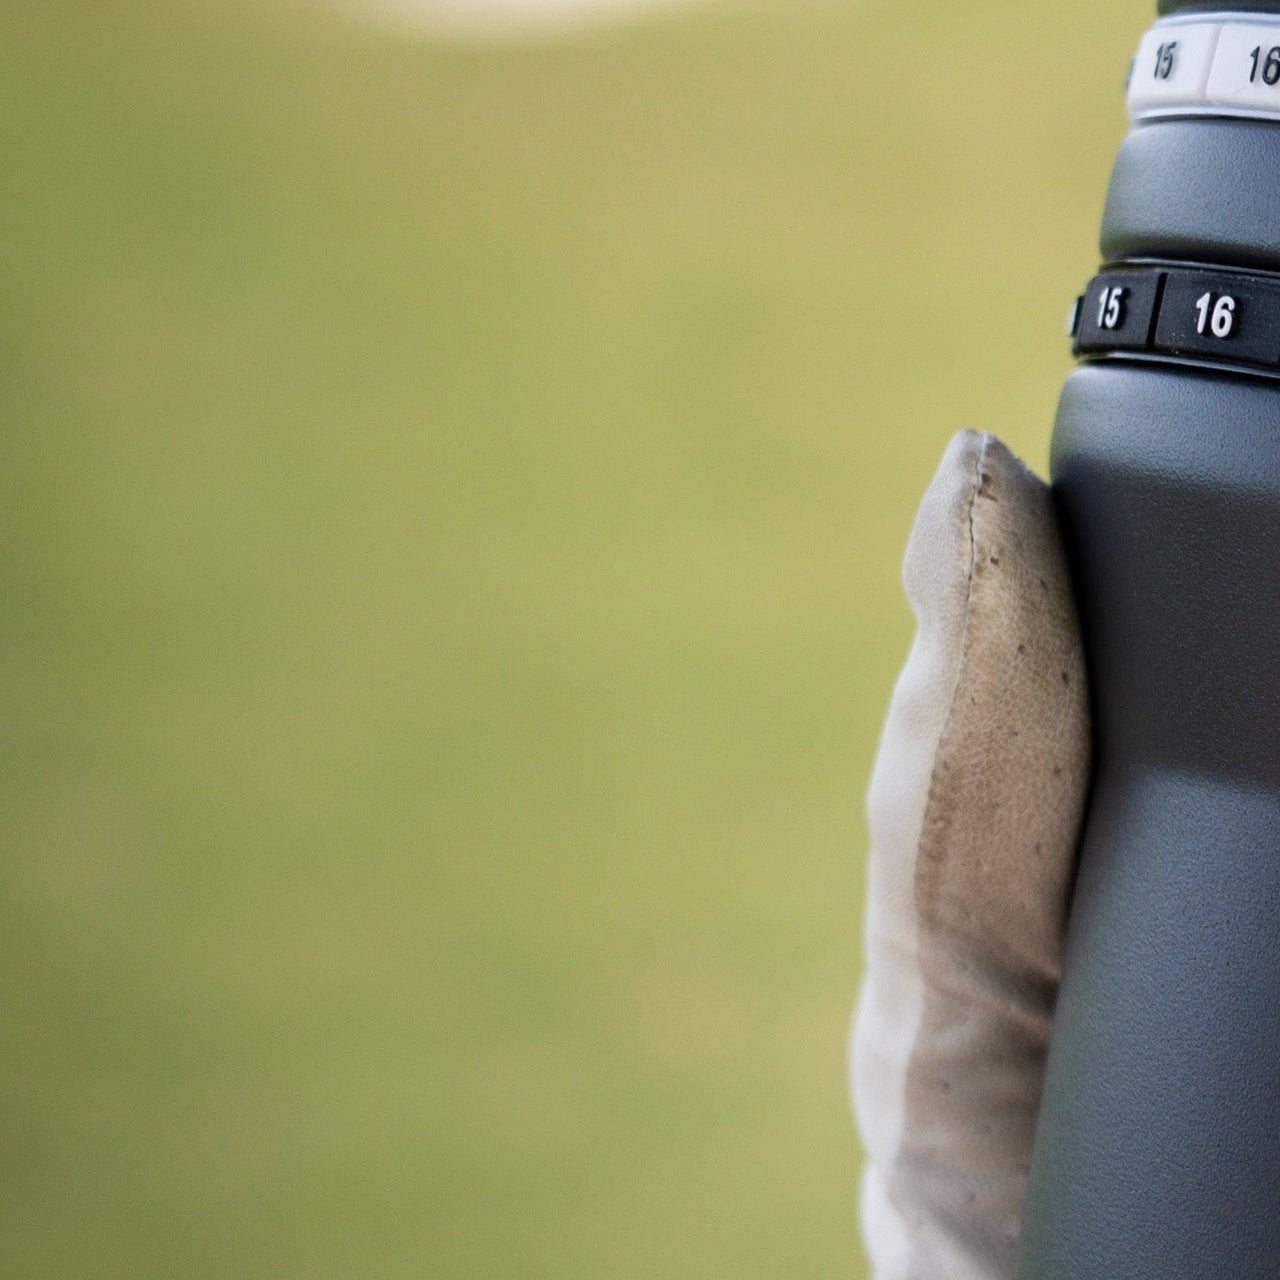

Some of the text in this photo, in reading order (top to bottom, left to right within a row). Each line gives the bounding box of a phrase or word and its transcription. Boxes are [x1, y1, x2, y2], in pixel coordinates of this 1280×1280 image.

[1153, 41, 1176, 80] 15
[1097, 286, 1122, 329] 15
[1196, 292, 1236, 338] 16
